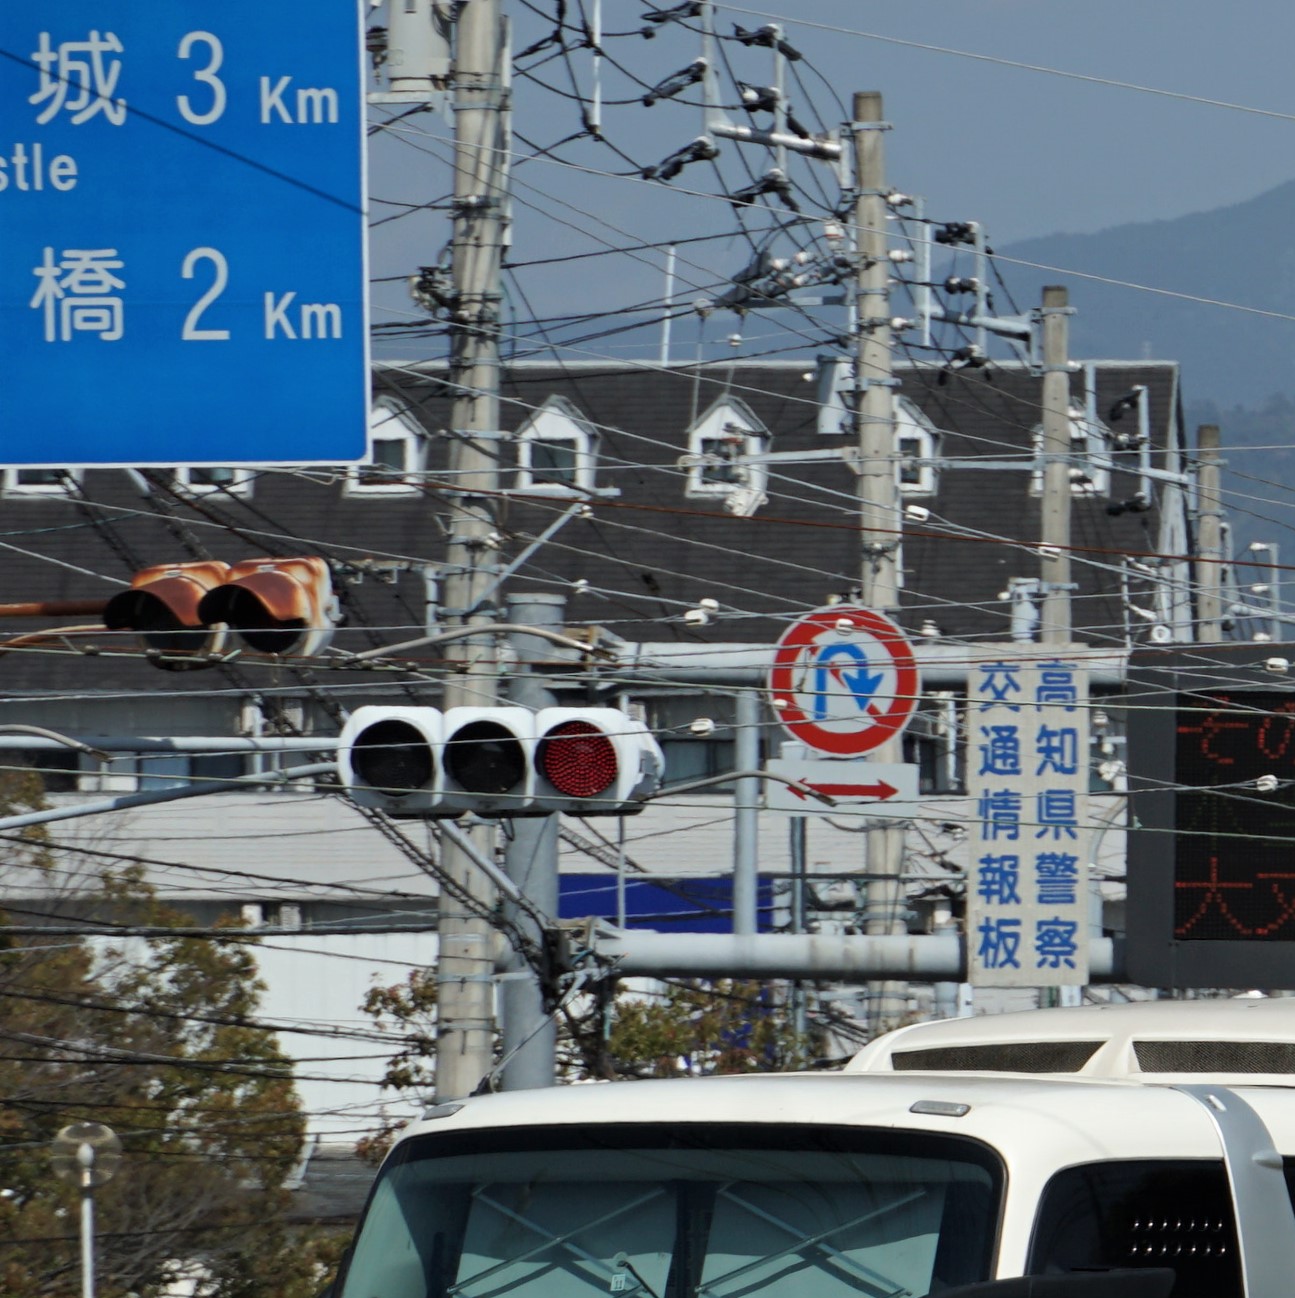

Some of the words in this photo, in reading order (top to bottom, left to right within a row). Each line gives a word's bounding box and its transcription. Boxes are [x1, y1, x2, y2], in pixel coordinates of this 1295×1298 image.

[28, 30, 127, 126] 城
[176, 31, 227, 125] 3
[260, 76, 339, 124] Km
[30, 247, 126, 342] 橋
[181, 247, 230, 341] 2
[264, 291, 343, 340] Km
[978, 660, 1022, 969] 交通情報板
[1035, 658, 1078, 970] 高知県警察
